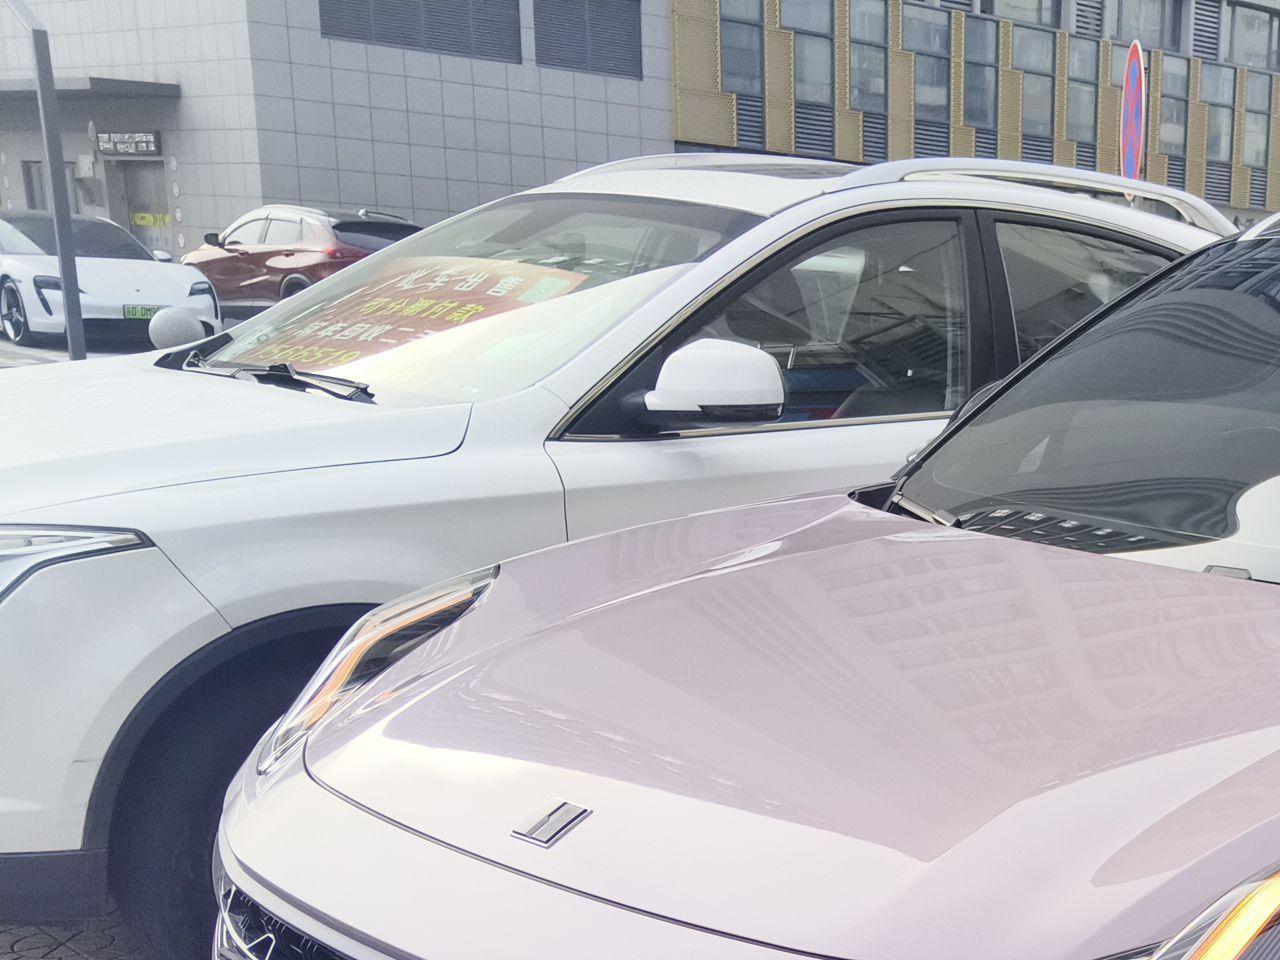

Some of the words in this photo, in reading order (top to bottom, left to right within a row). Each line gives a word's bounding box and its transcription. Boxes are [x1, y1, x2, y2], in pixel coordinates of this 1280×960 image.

[359, 297, 485, 324] 可分期付款
